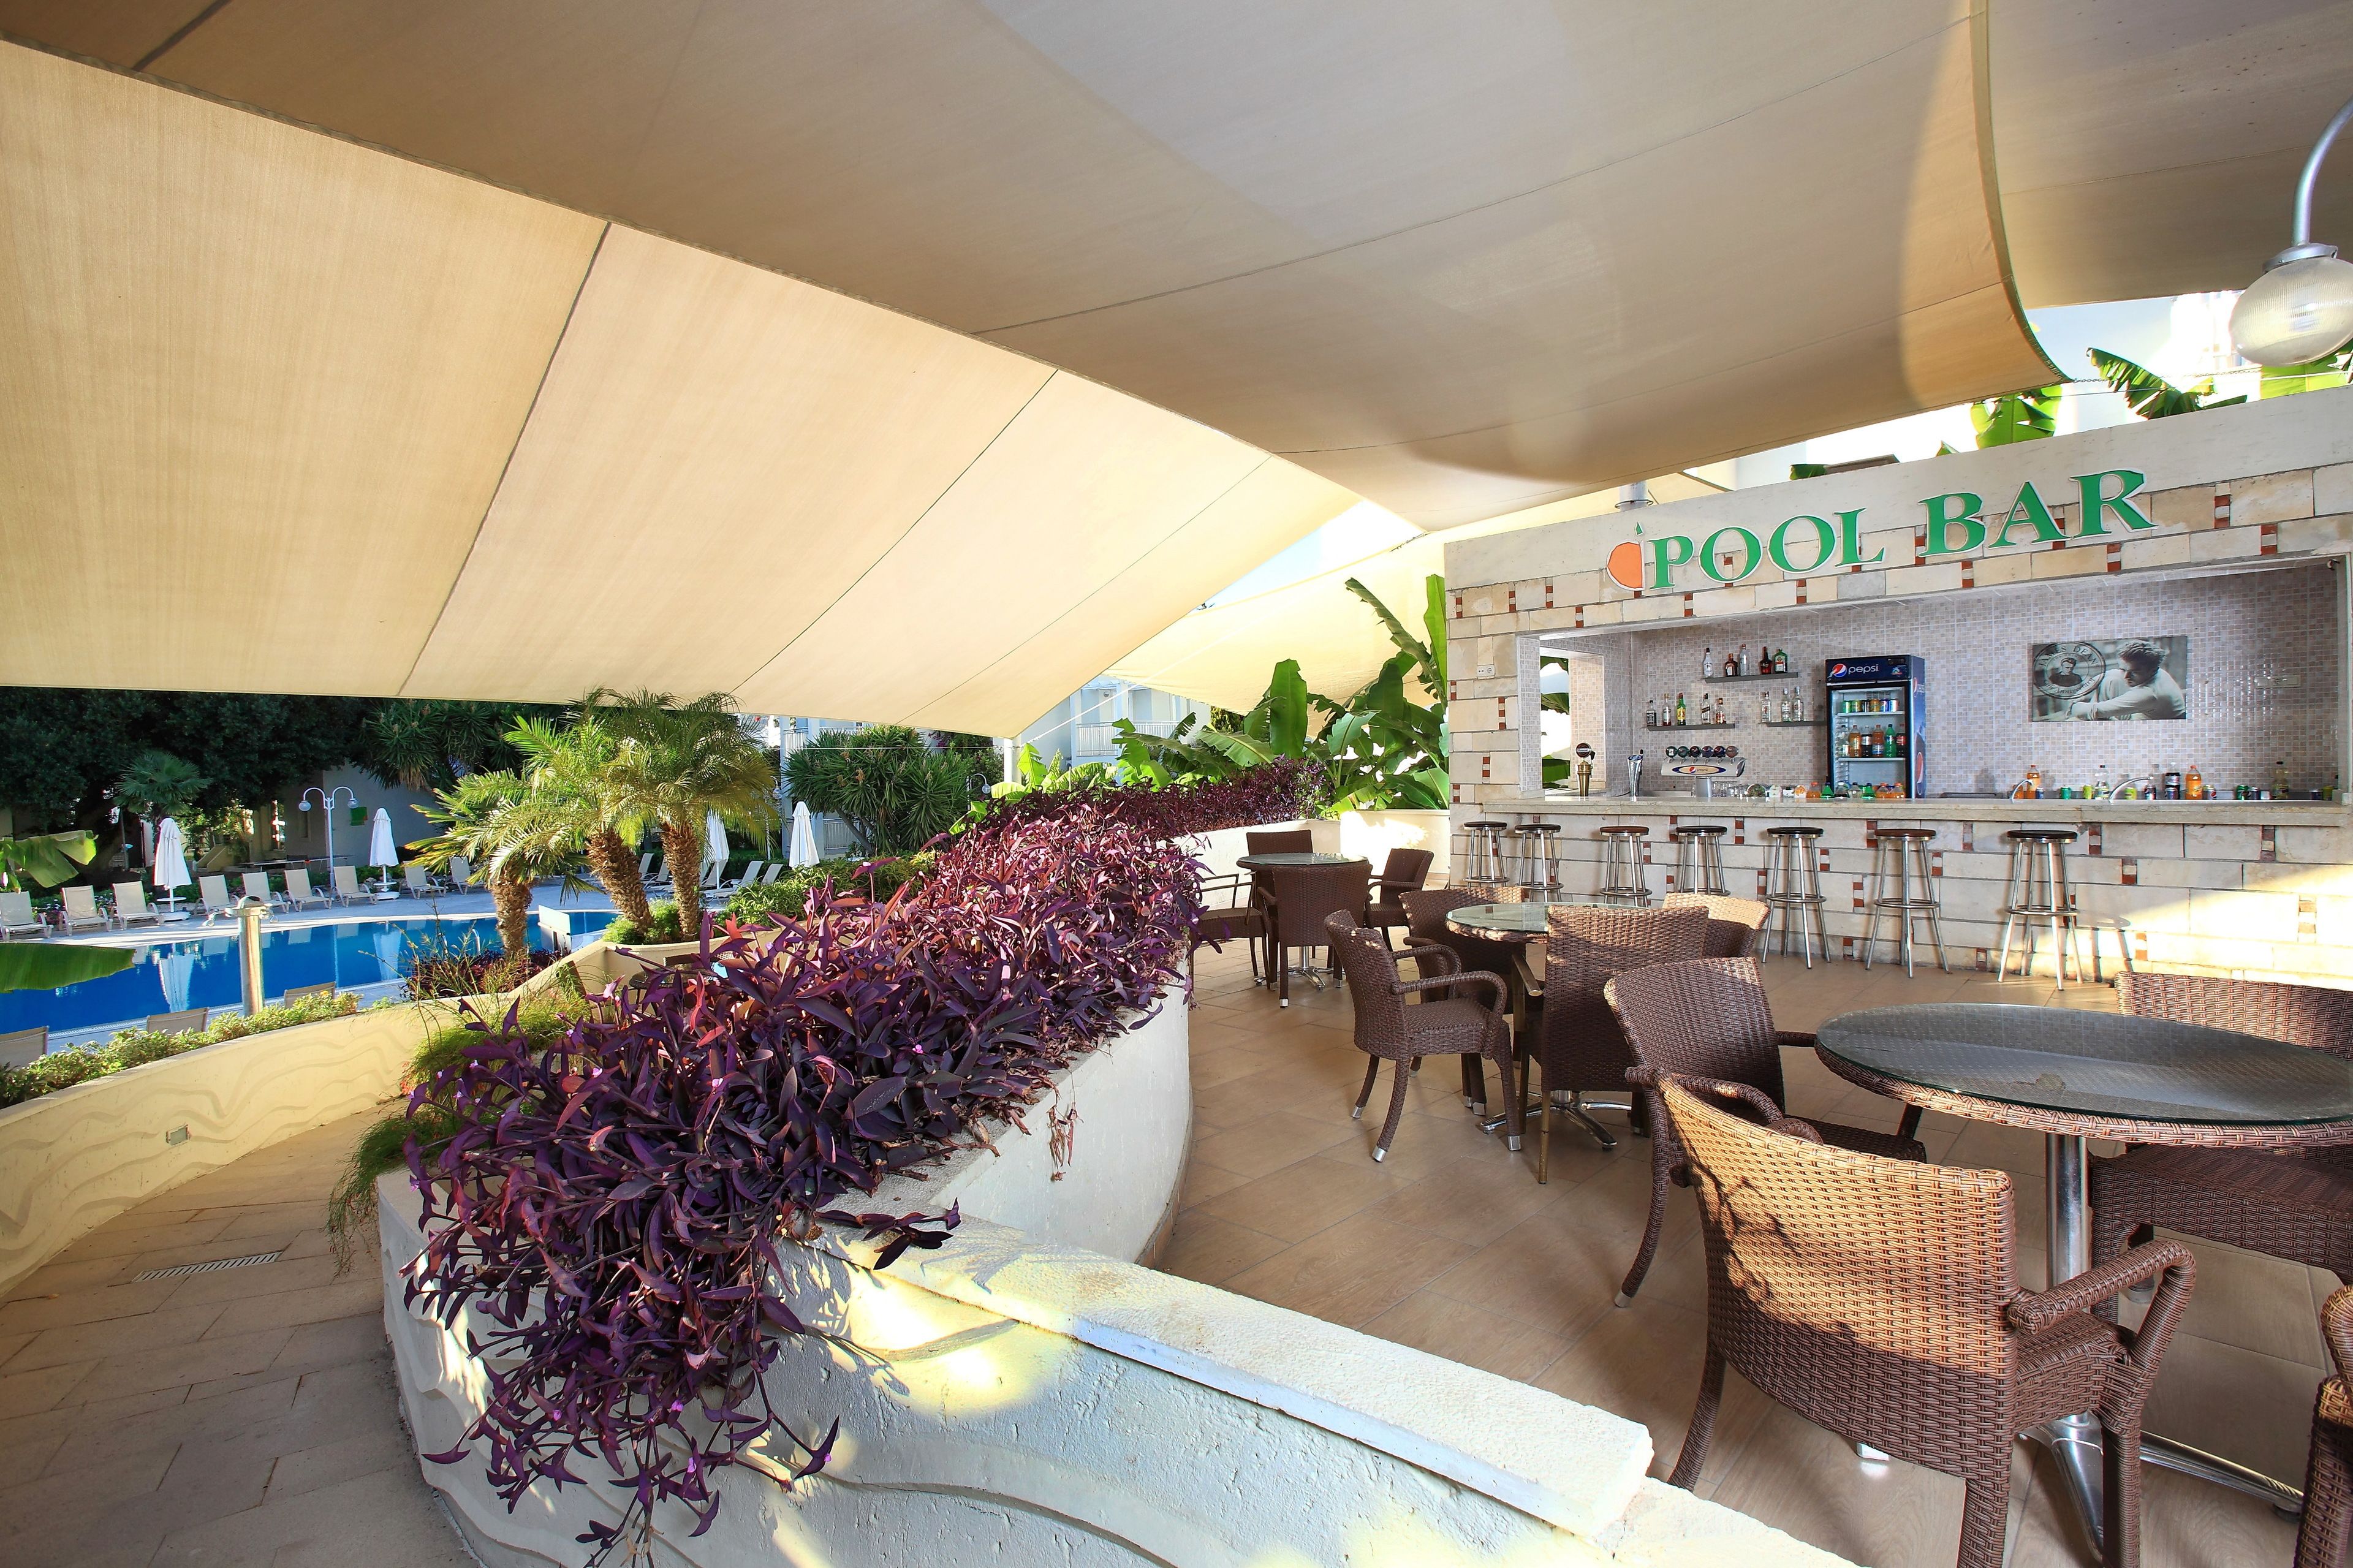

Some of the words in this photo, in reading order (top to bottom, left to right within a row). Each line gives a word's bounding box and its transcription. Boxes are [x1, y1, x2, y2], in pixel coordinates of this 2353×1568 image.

[1649, 507, 1885, 590] POOL
[1918, 468, 2159, 557] BAR
[2073, 646, 2098, 665] DEAN
[1848, 664, 1879, 674] pepsi
[2057, 677, 2095, 694] Annivary
